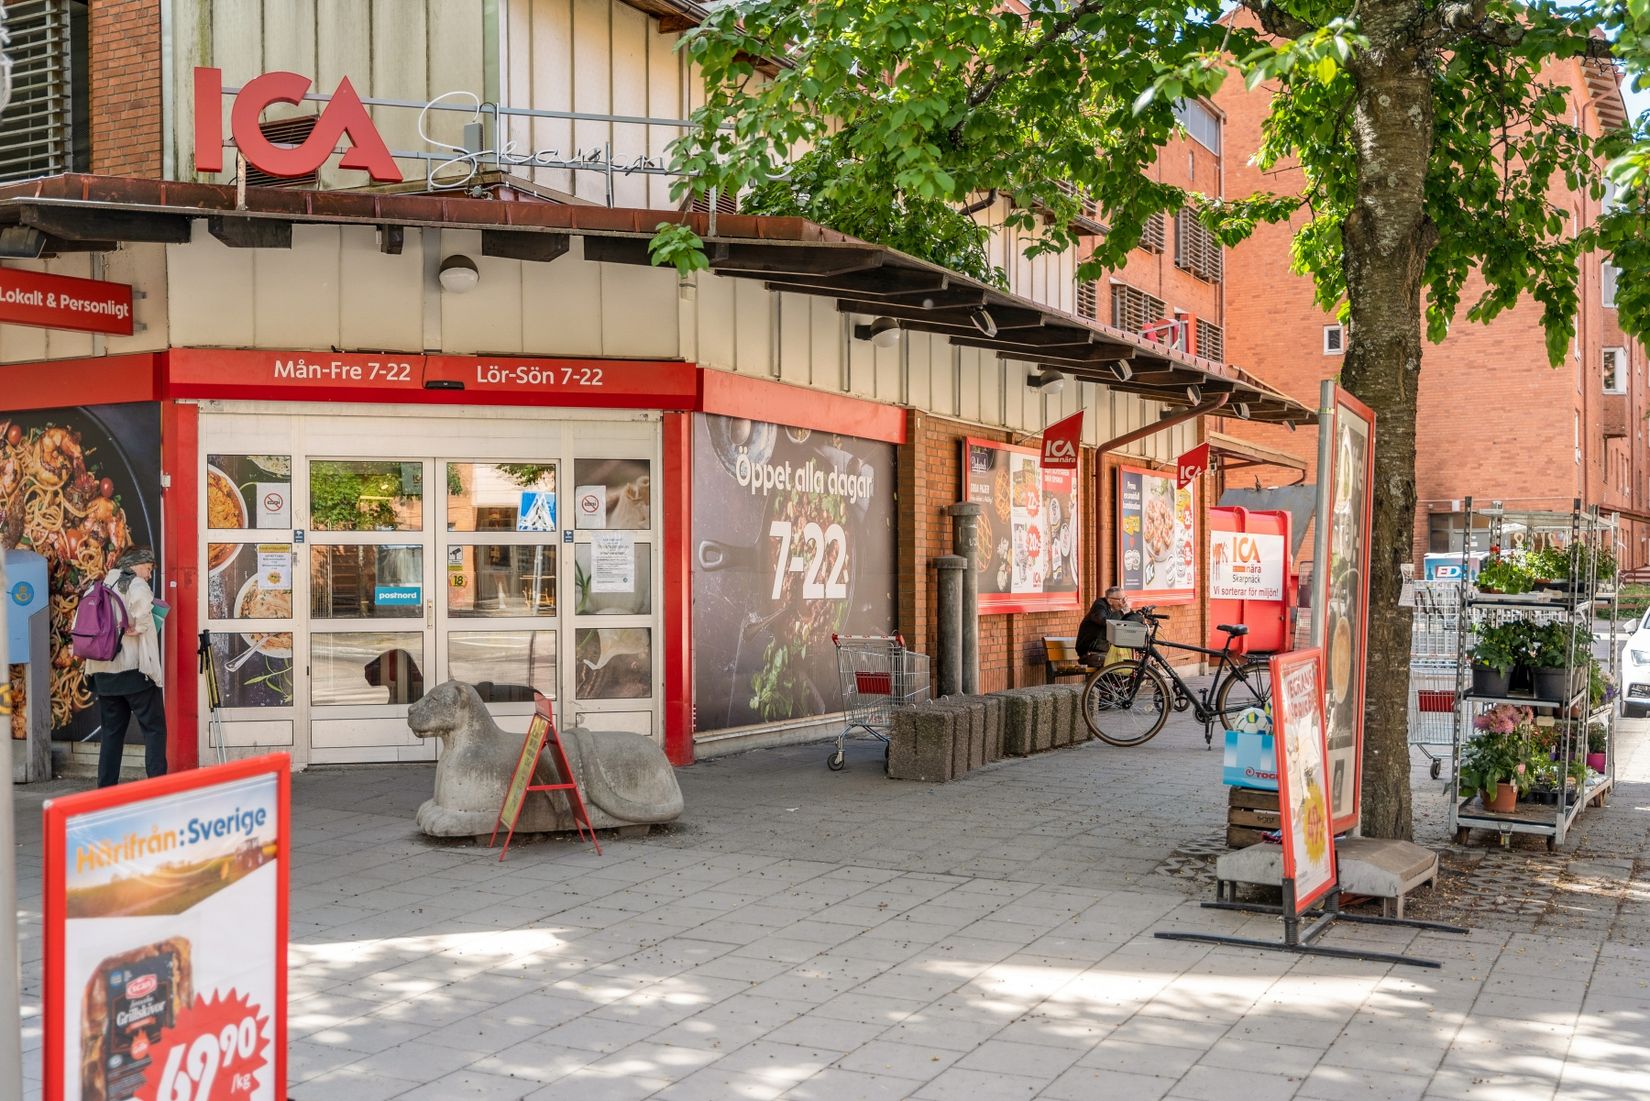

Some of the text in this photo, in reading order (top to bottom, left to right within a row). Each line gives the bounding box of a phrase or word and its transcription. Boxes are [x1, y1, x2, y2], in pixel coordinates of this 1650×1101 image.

[194, 66, 404, 183] ICA
[0, 286, 129, 319] Lokalt & Personligt
[274, 359, 411, 381] Mån-Fre 7-22
[476, 364, 604, 386] Lör-Sön 7-22
[1045, 439, 1076, 457] ICA
[735, 446, 873, 504] Öppet alla dagar
[769, 520, 847, 600] 7-22
[1233, 536, 1261, 563] ICA
[1246, 564, 1261, 573] nära
[453, 575, 464, 586] 18
[379, 591, 417, 600] postnord
[1213, 586, 1279, 598] Vi sorterar för miljön!
[230, 1073, 251, 1094] /kg
